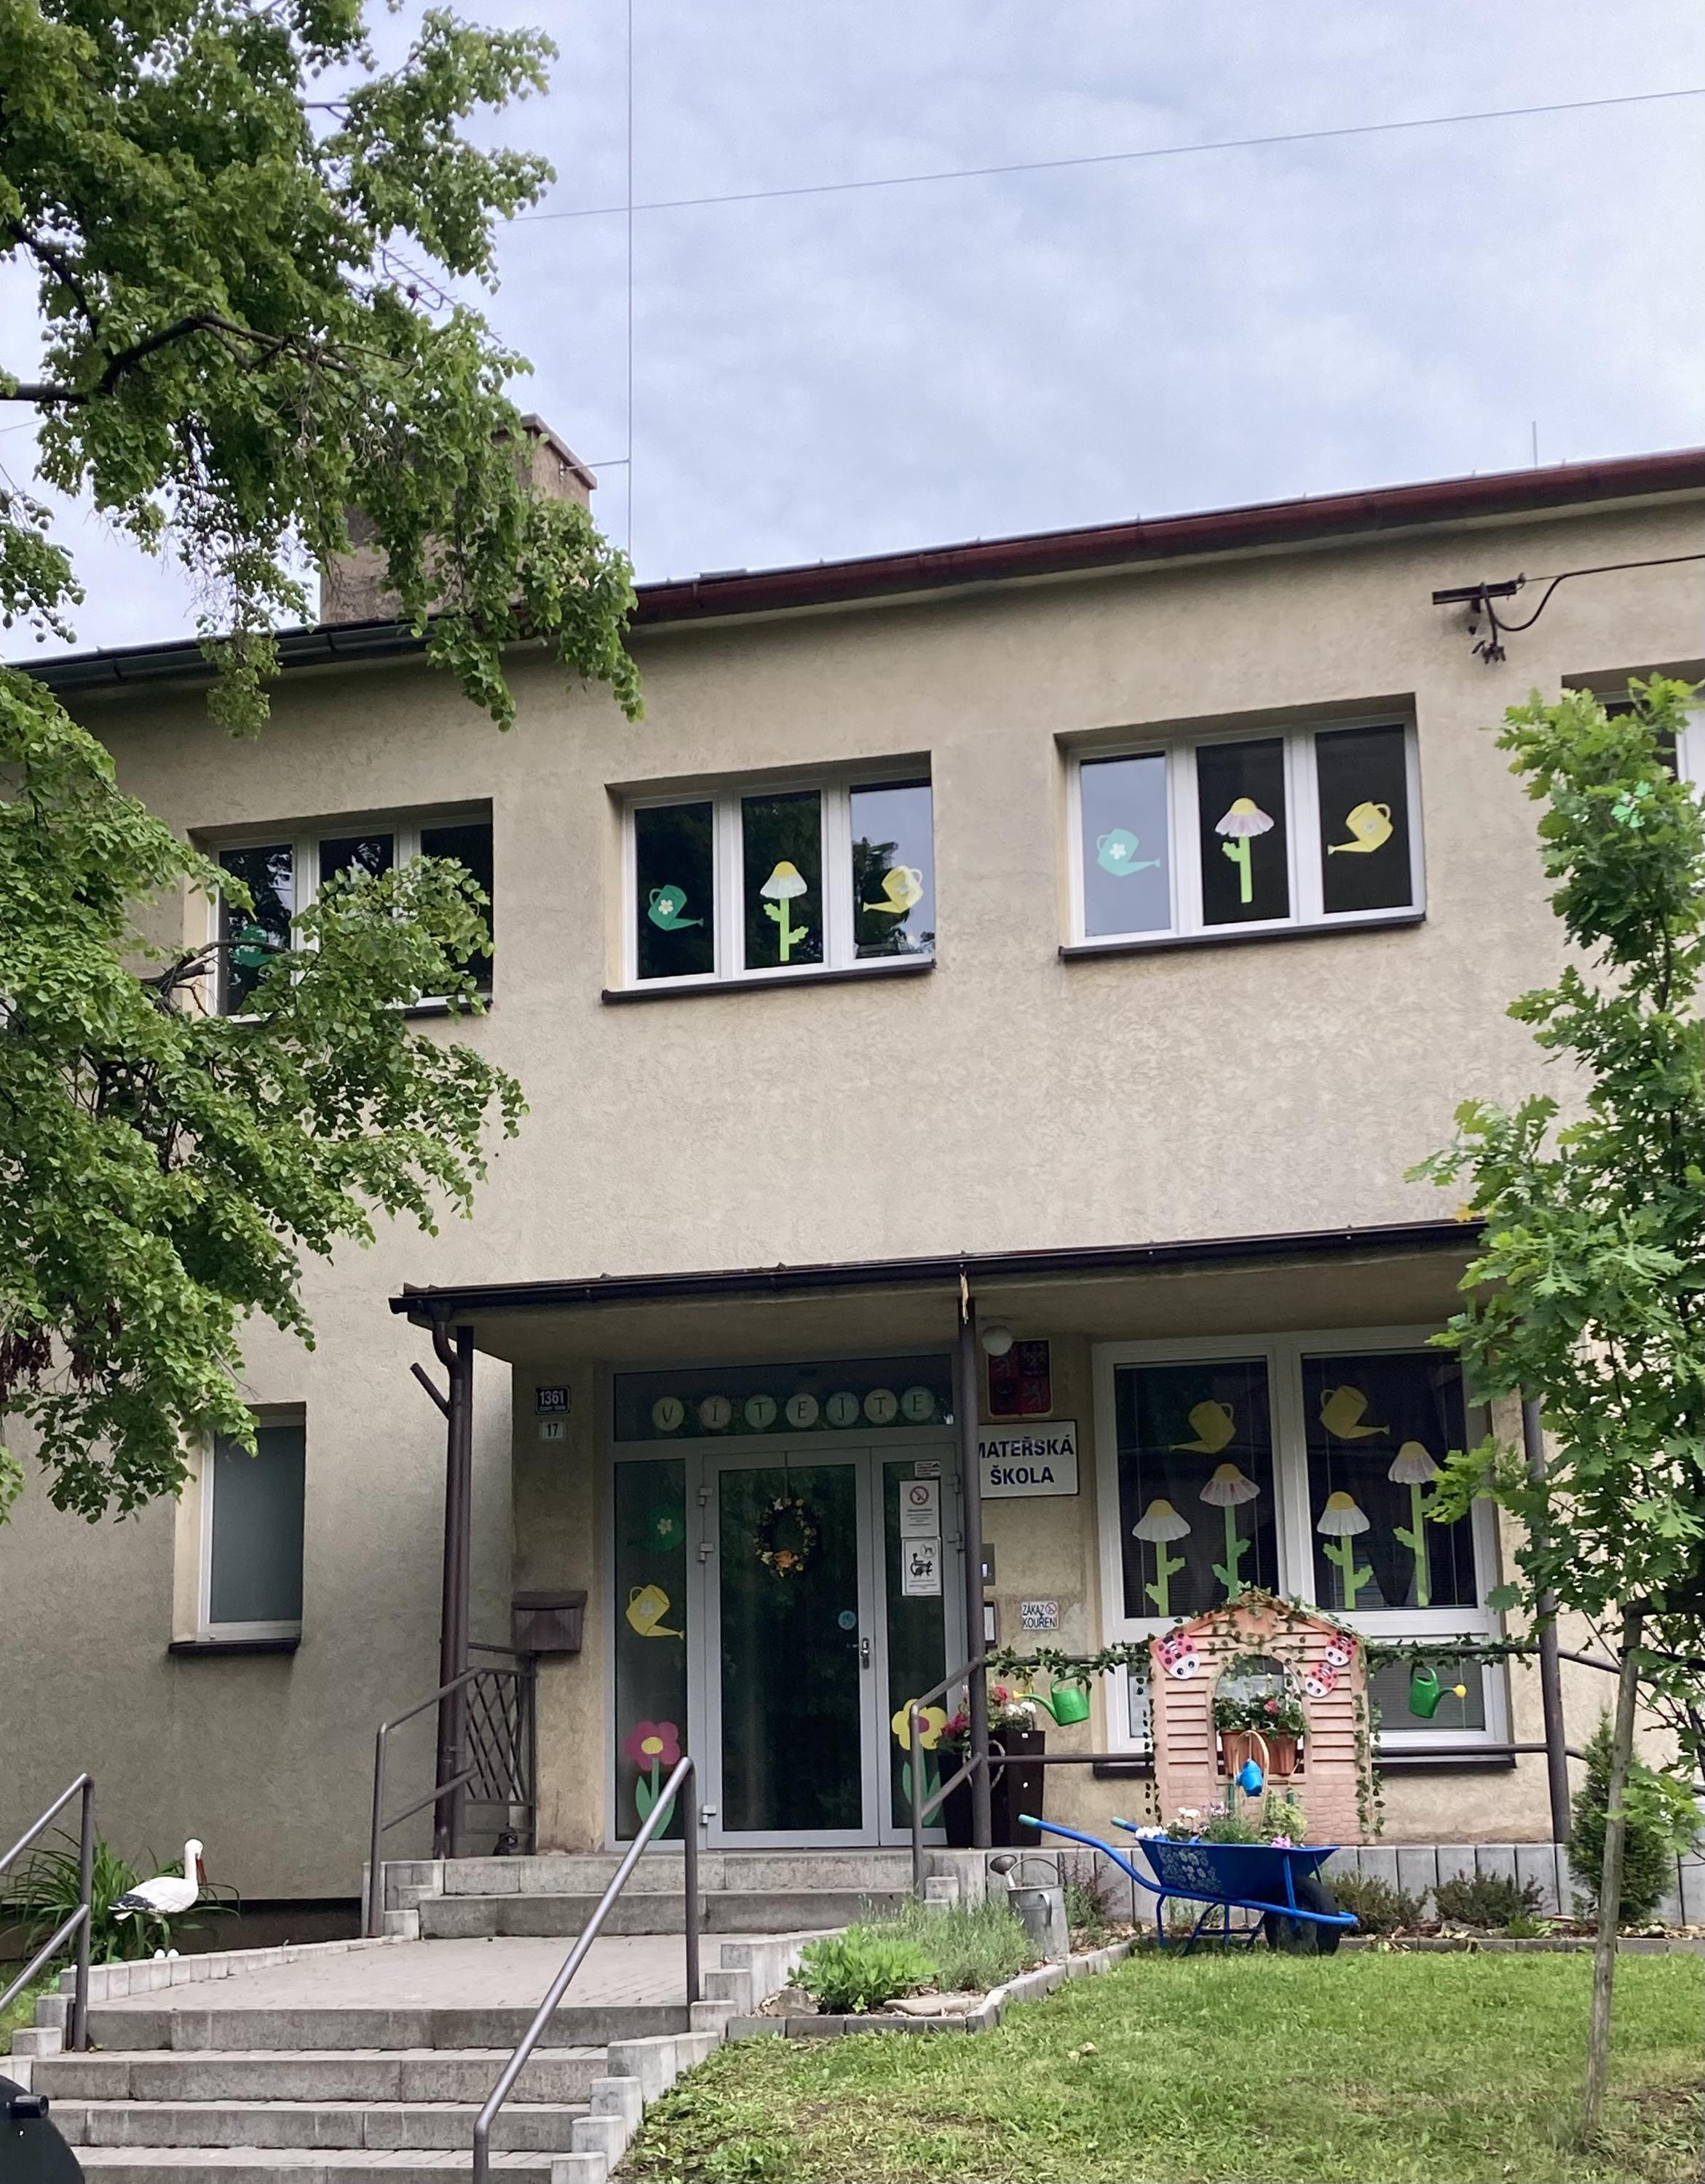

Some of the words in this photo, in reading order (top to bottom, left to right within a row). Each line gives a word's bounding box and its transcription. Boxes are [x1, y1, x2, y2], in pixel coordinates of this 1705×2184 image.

[539, 1390, 564, 1405] 1361
[547, 1423, 558, 1437] 17
[990, 1465, 1054, 1485] ŠKOLA
[1023, 1602, 1044, 1615] ZÁKAZ
